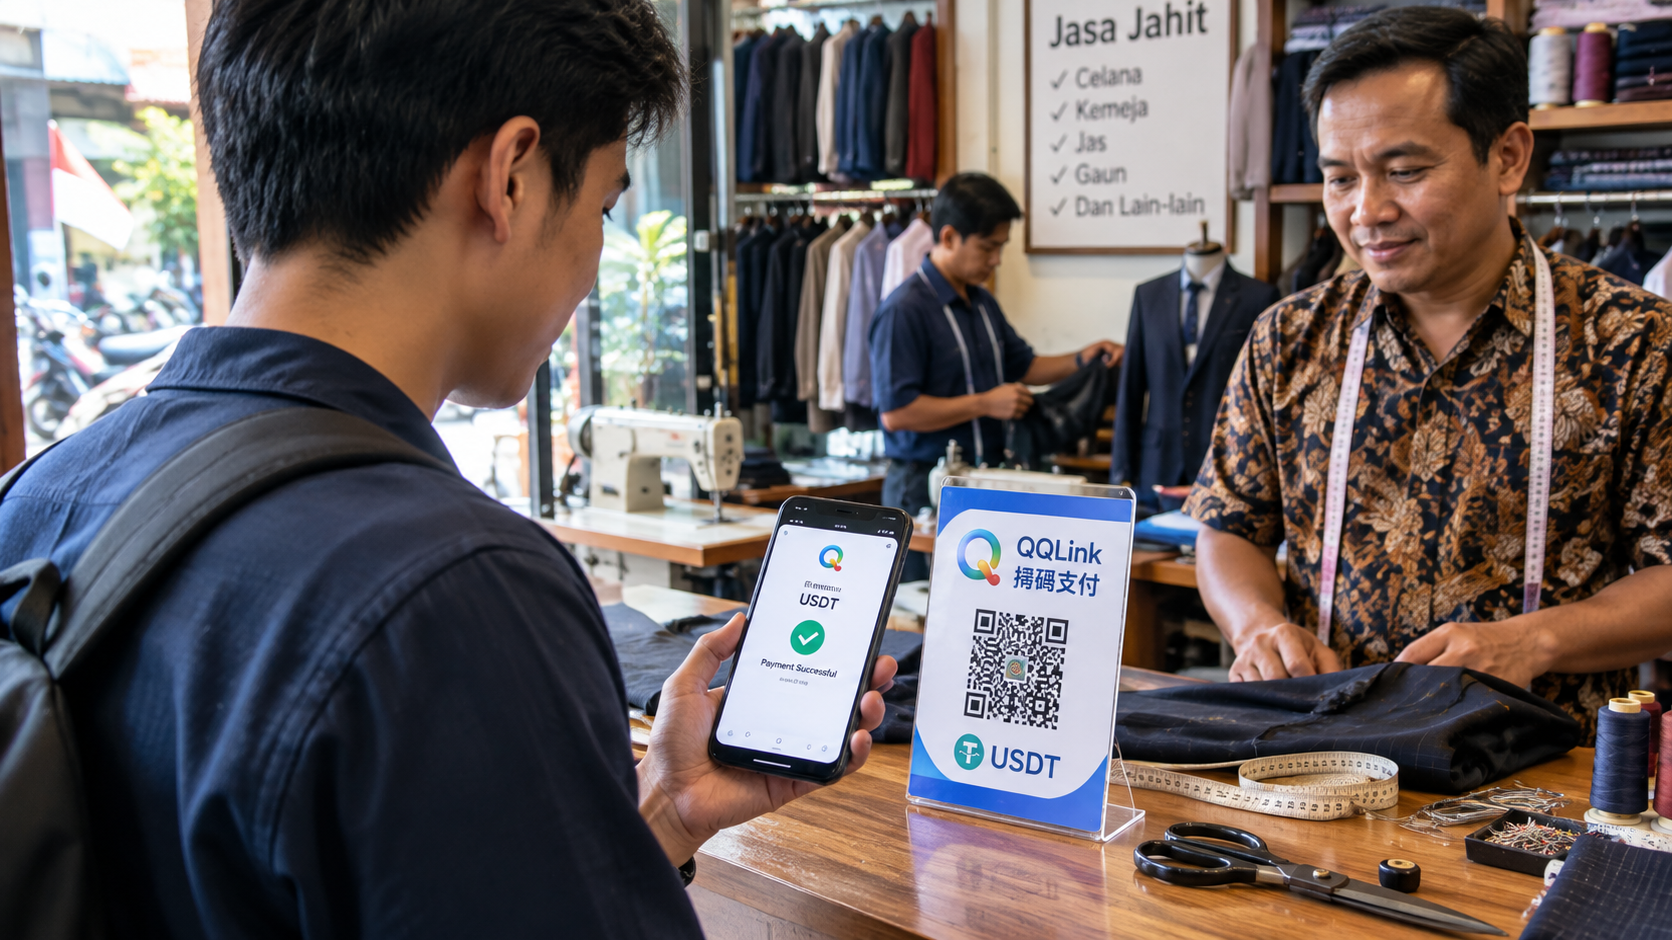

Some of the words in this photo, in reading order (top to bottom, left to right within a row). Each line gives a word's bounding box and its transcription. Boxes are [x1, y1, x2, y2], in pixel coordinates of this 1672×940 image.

[1049, 15, 1117, 48] Jasa
[1128, 0, 1208, 41] Jahit
[1075, 66, 1143, 89] Celana
[1075, 97, 1149, 124] Kemeja
[1075, 131, 1108, 154] Jas
[1075, 163, 1127, 186] Gaun
[1075, 195, 1114, 217] Dan
[1119, 192, 1205, 217] Lain-lain
[1017, 535, 1103, 565] QQLink
[799, 593, 840, 610] USDT
[760, 658, 795, 671] Payment
[795, 664, 838, 678] Successful
[990, 745, 1061, 779] USDT
